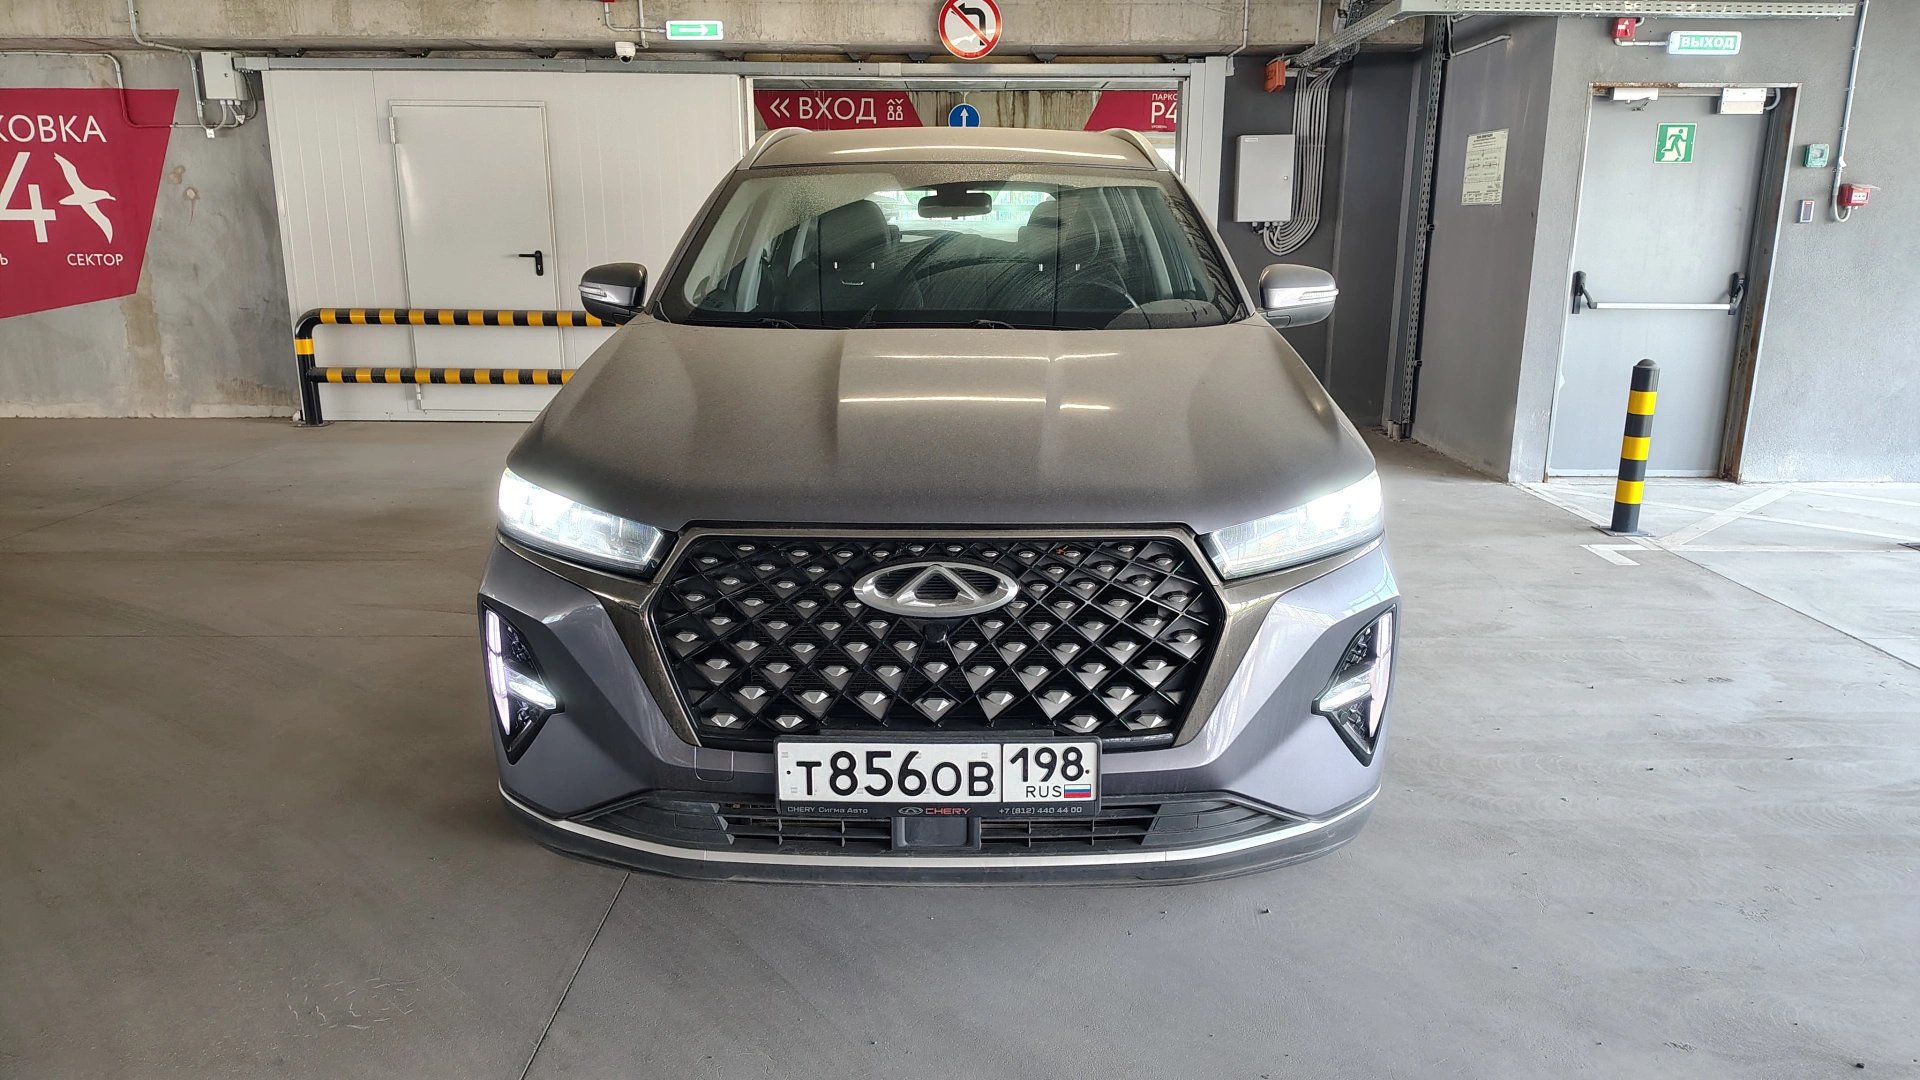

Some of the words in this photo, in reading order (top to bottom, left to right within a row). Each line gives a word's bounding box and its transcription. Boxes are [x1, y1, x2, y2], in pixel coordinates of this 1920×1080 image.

[1681, 36, 1735, 50] ВЫХОД
[799, 97, 877, 124] ВХОД
[1151, 101, 1177, 124] P4
[66, 253, 124, 266] СЕКТОР
[796, 750, 994, 796] Т856ОВ
[1010, 746, 1084, 782] 198
[1025, 785, 1062, 798] RUS
[925, 807, 971, 815] CHERY
[1011, 807, 1035, 815] (812)
